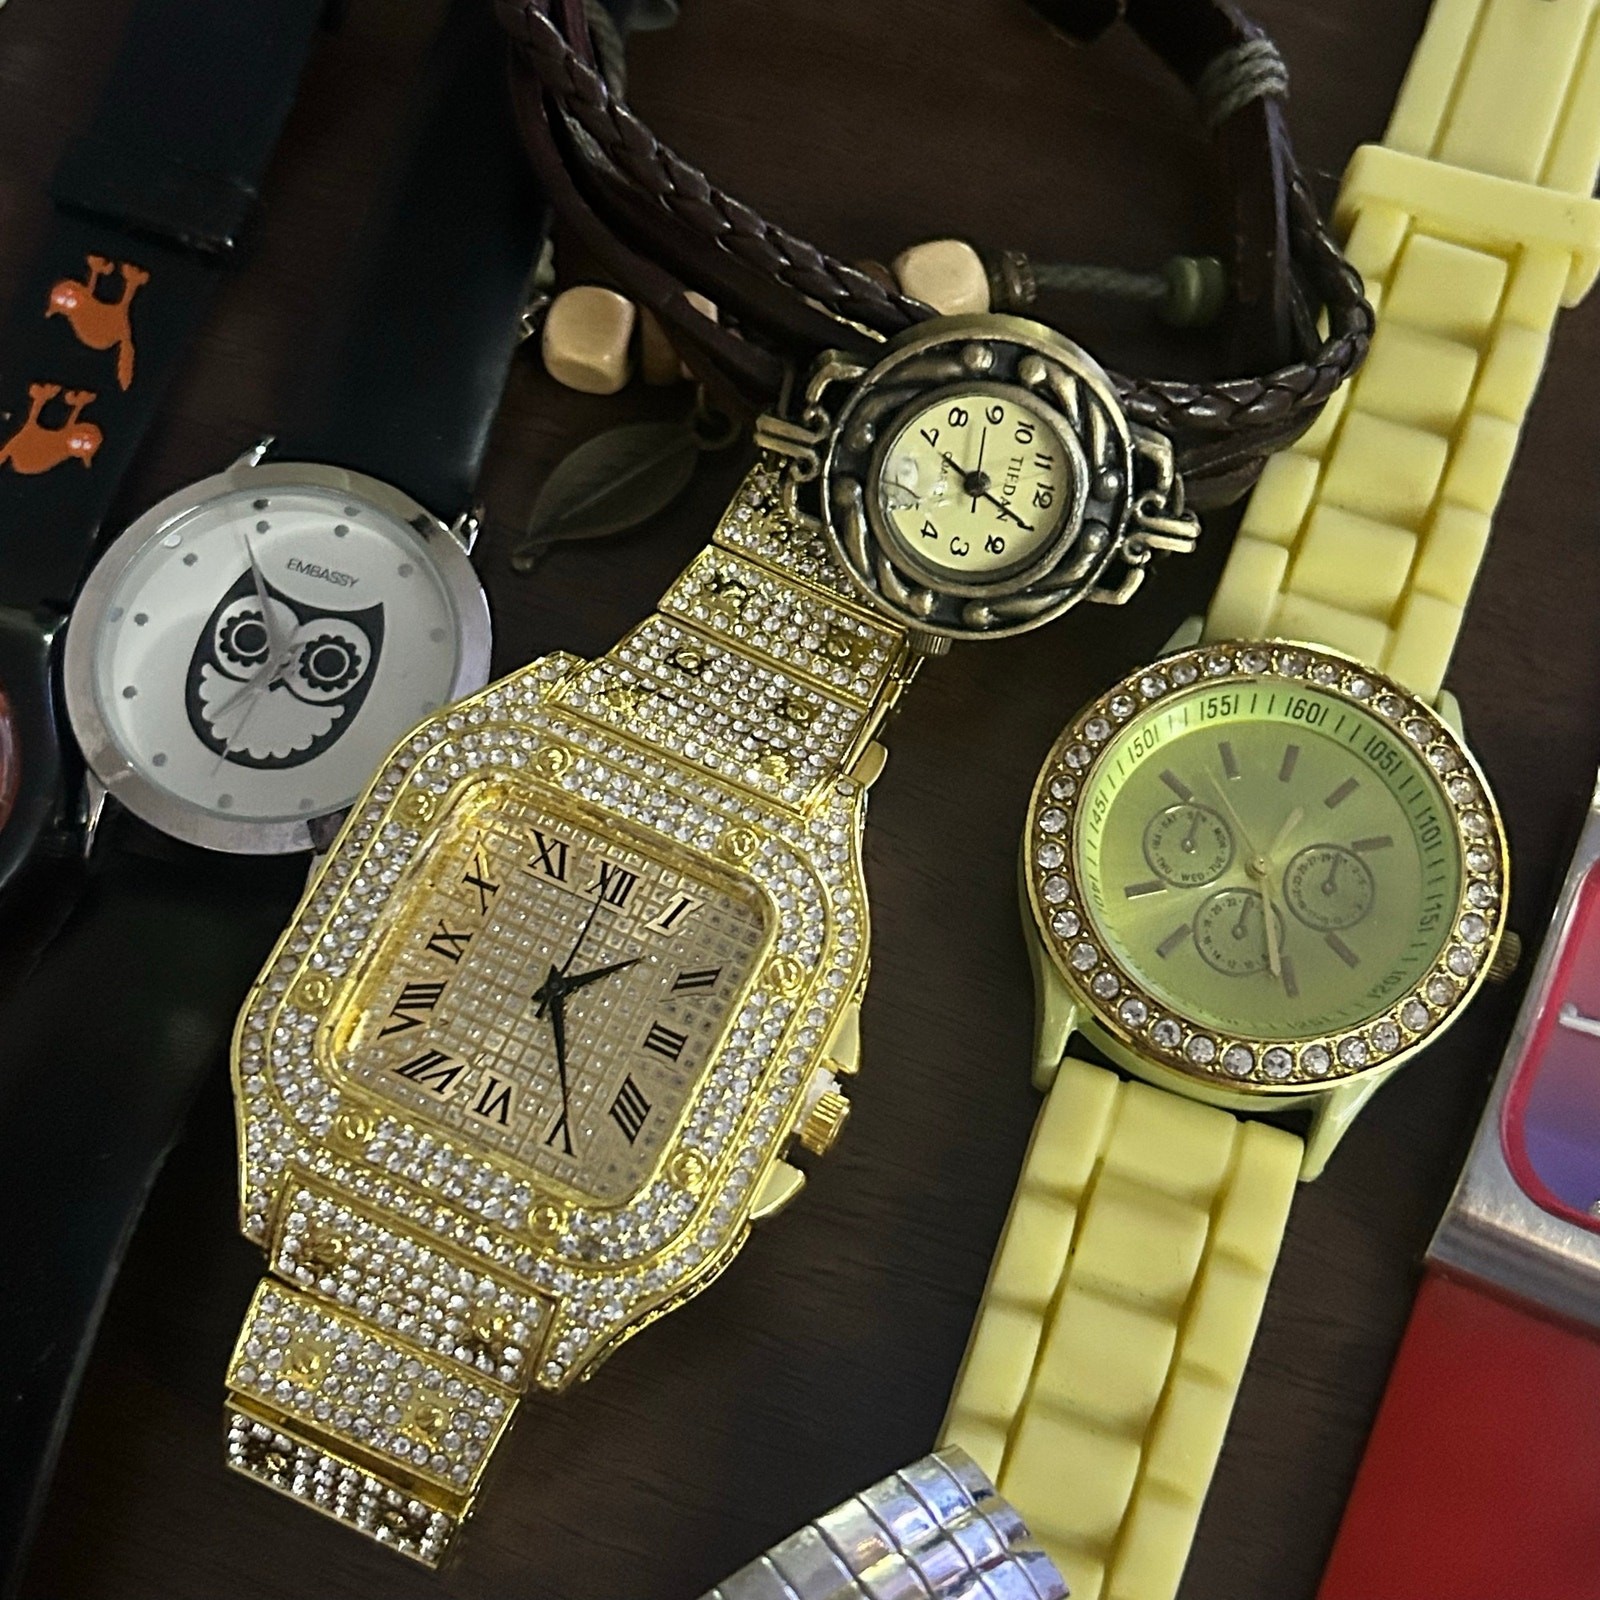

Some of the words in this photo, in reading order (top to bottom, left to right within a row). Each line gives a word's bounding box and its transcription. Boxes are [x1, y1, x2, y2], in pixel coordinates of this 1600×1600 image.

[948, 407, 969, 428] 8
[985, 405, 1004, 425] 9
[920, 428, 940, 448] 7
[1014, 420, 1035, 445] 10
[1034, 453, 1054, 471] 11
[1032, 482, 1055, 509] 12
[920, 520, 938, 539] 4
[984, 534, 1005, 555] 2
[949, 536, 969, 557] 3
[286, 558, 360, 589] EMBASSY
[1291, 698, 1321, 724] 60
[527, 828, 570, 883] XI
[461, 852, 501, 916] X
[584, 860, 640, 909] XII
[656, 896, 694, 930] I
[425, 918, 474, 964] IX
[670, 965, 723, 992] II
[376, 979, 449, 1040] VIII
[643, 1019, 689, 1062] III
[391, 1048, 466, 1095] VII
[472, 1075, 513, 1127] VI
[608, 1072, 652, 1147] IIII
[544, 1104, 578, 1158] V
